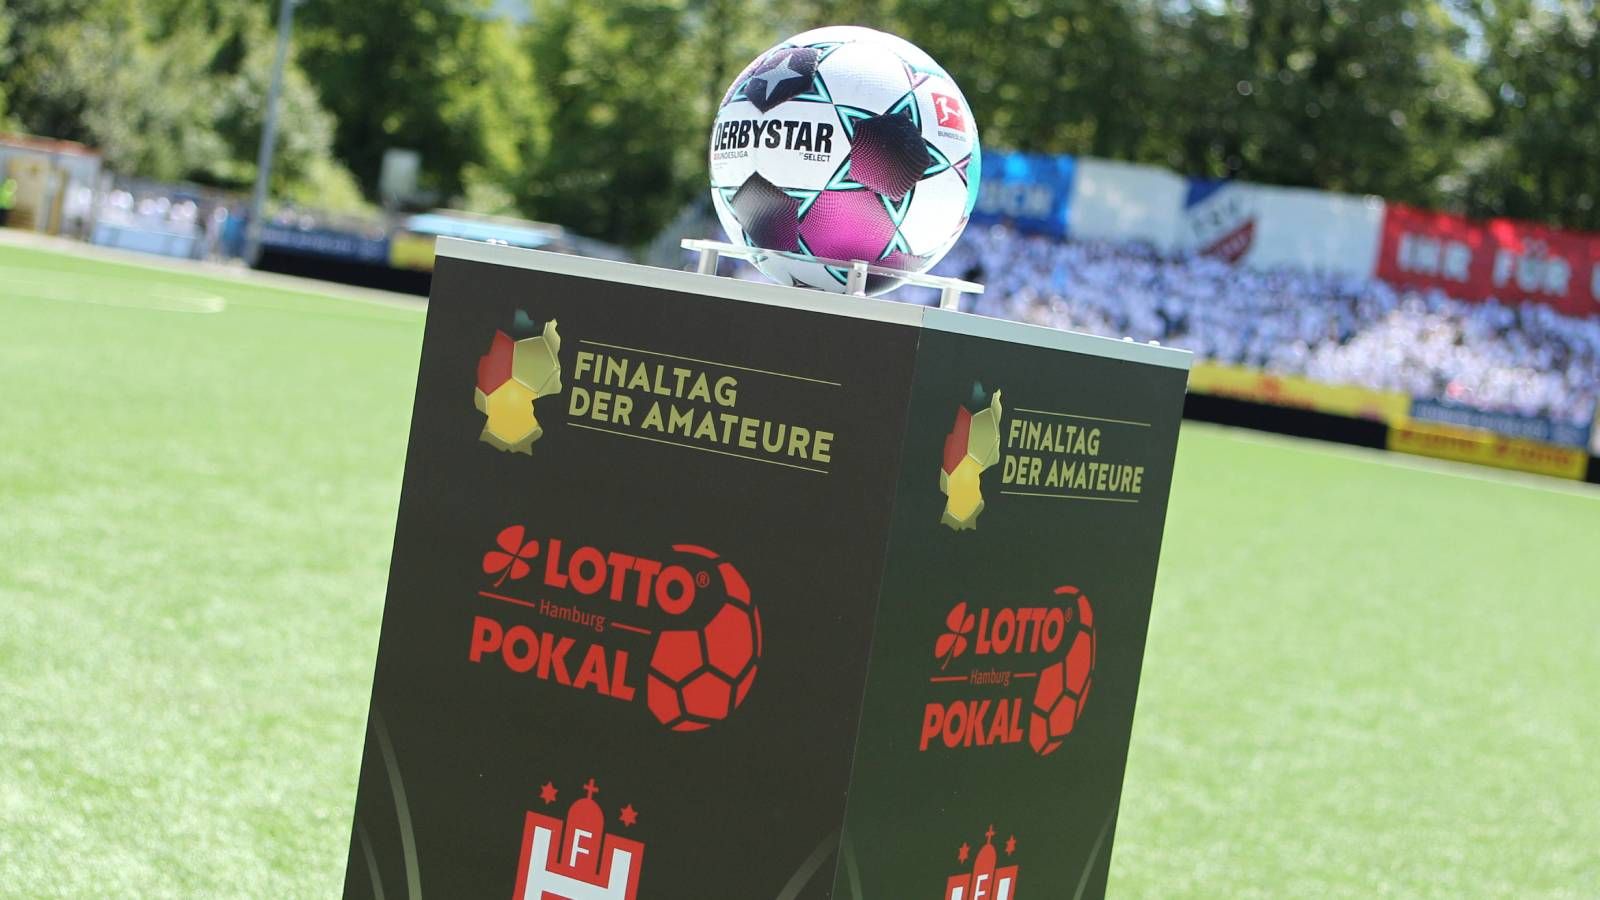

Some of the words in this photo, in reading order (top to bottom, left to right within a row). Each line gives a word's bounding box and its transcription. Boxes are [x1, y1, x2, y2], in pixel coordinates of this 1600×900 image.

[714, 119, 834, 154] DERBYSTAR
[803, 152, 831, 163] SELECT
[1397, 230, 1472, 284] IHR
[1493, 236, 1571, 297] FÜR
[574, 350, 738, 407] FINALTAG
[568, 386, 633, 425] DER
[641, 401, 836, 463] AMATEURE
[1007, 419, 1101, 456] FINALTAG
[1002, 455, 1043, 486] DER
[1045, 460, 1145, 494] AMATEURE
[539, 600, 606, 633] Hamburg
[469, 615, 636, 703] POKAL
[970, 669, 1011, 687] Hamburg
[919, 697, 1024, 752] POKAL
